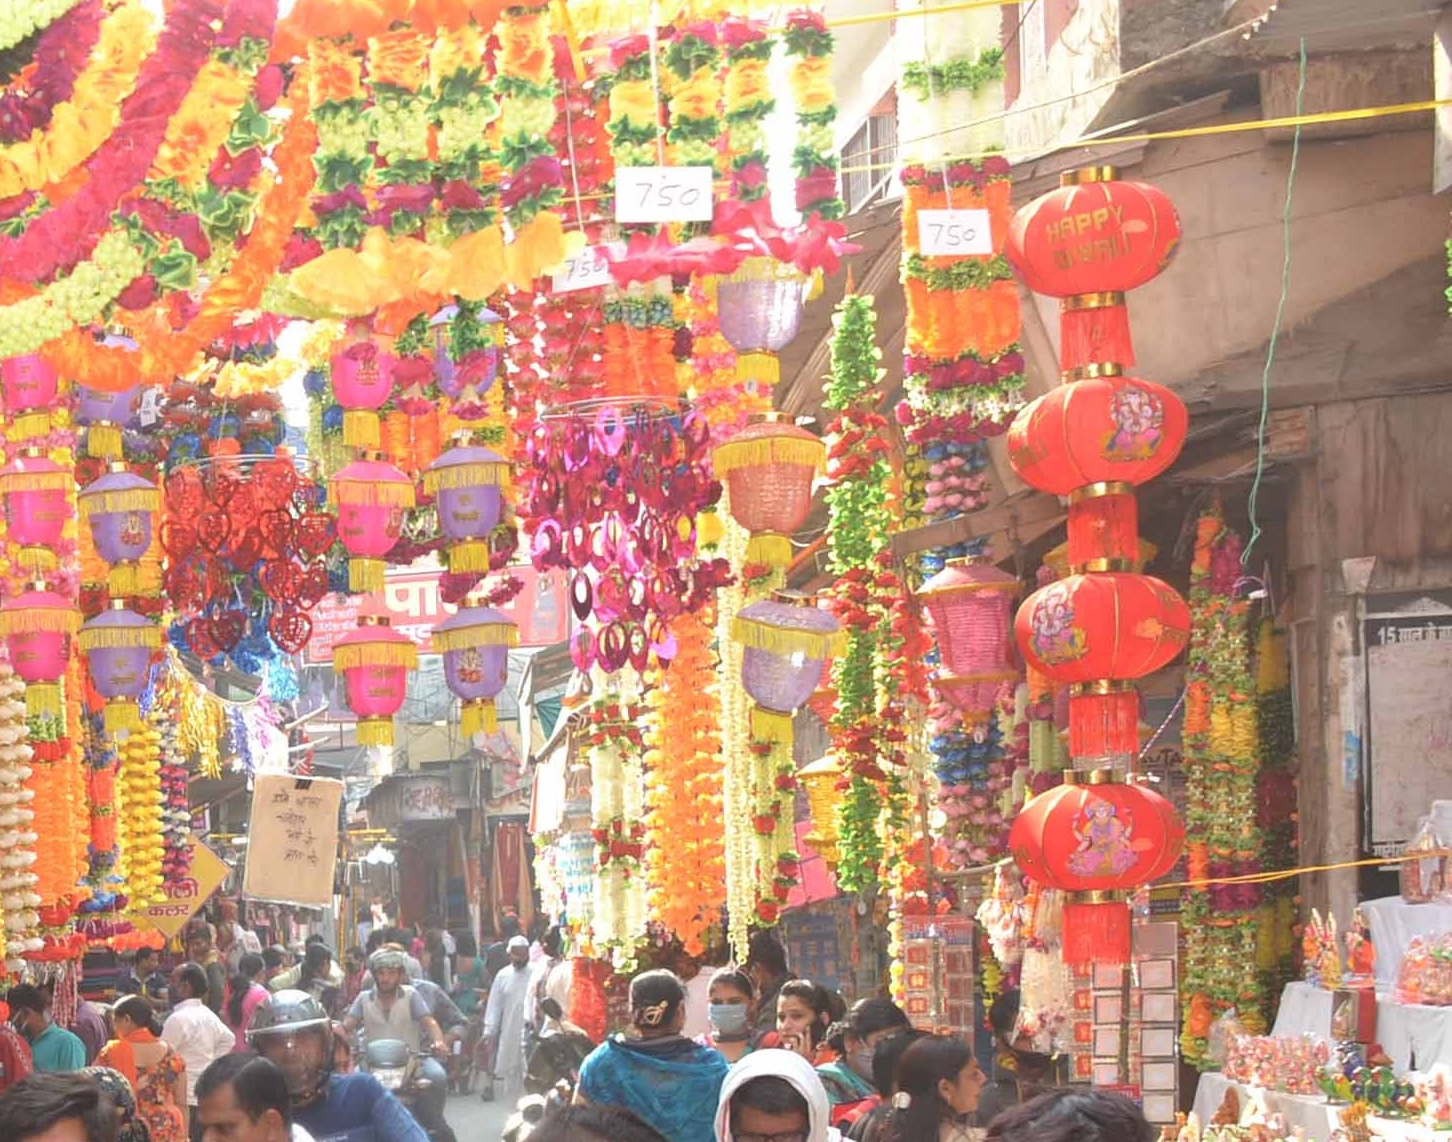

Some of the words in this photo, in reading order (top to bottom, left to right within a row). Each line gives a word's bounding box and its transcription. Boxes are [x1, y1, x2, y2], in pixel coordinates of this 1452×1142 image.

[635, 182, 700, 208] 750
[927, 223, 976, 246] 750
[1045, 203, 1125, 245] HAPPY
[148, 904, 189, 917] कलर
